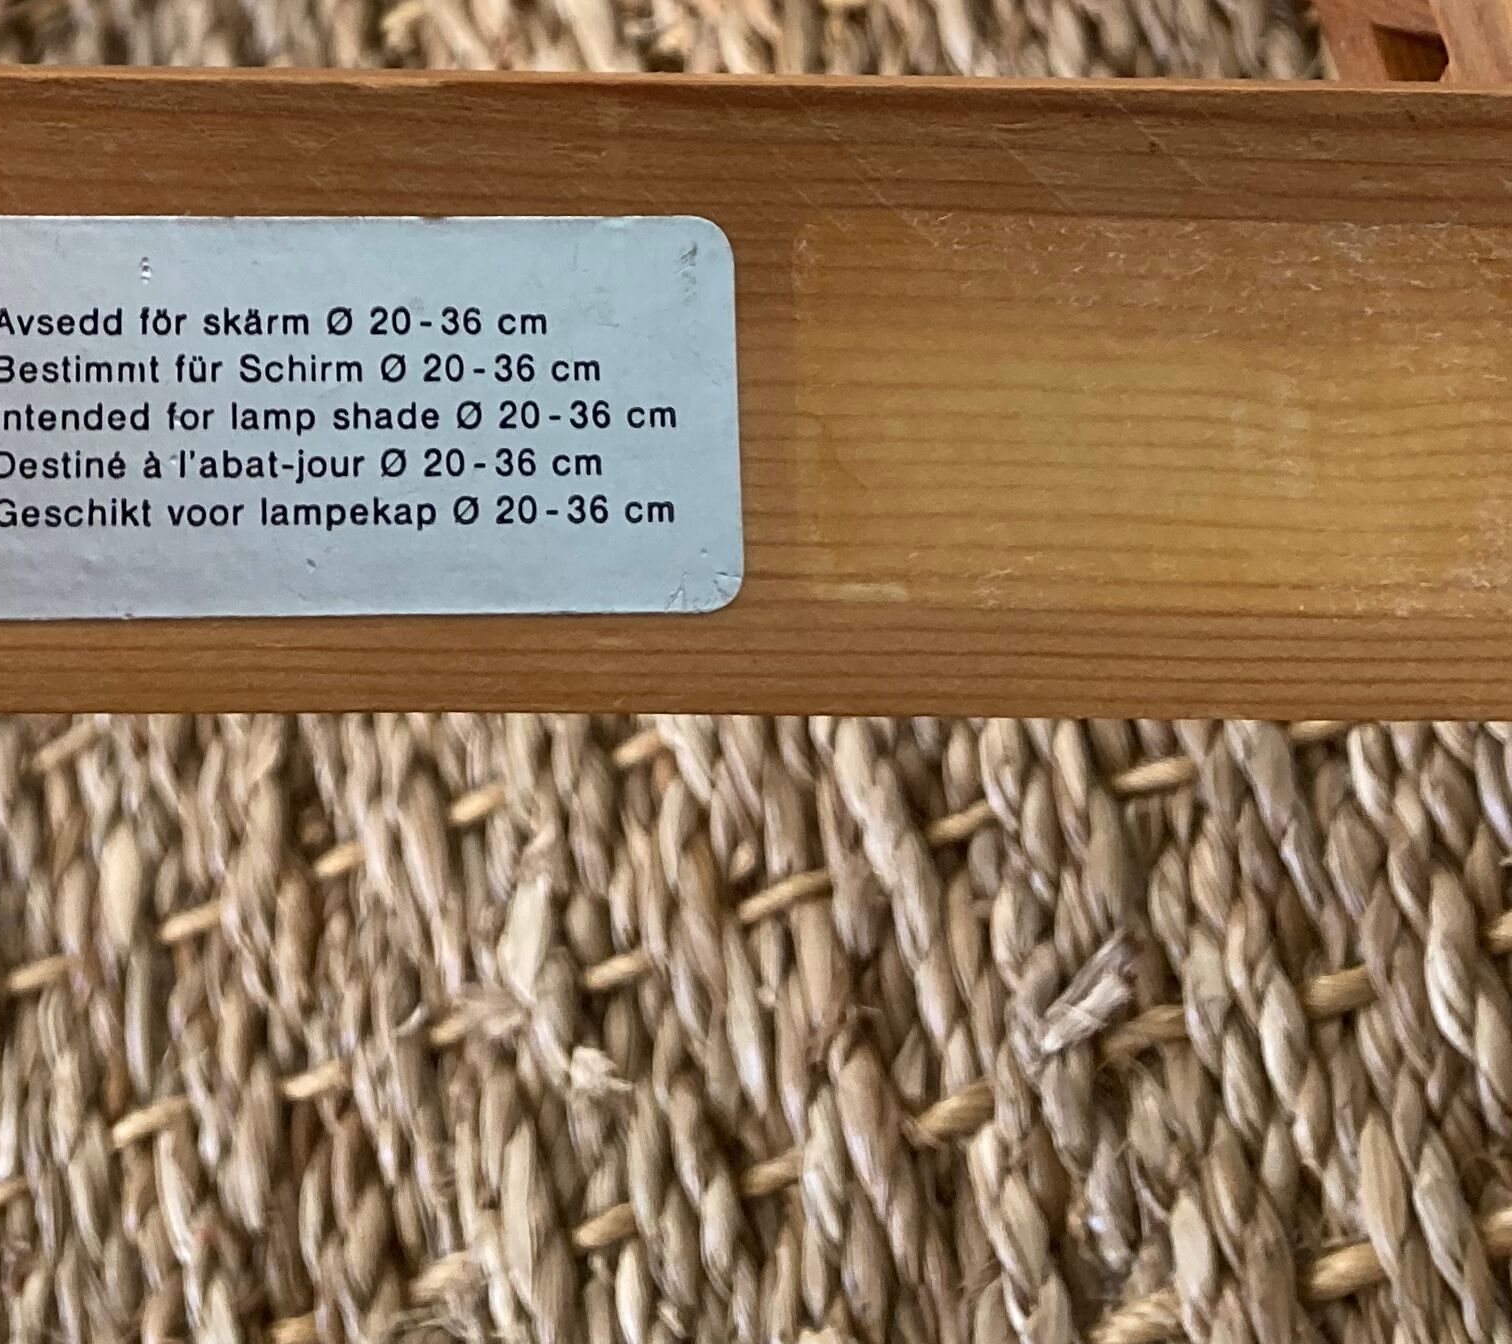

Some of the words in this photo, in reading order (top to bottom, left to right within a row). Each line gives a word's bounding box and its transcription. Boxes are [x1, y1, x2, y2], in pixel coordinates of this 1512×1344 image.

[139, 306, 188, 337] för
[202, 306, 310, 337] skärm
[326, 306, 353, 337] Ø
[369, 305, 482, 336] 20-36
[497, 313, 548, 336] cm
[174, 353, 224, 384] für
[239, 353, 363, 384] Schirm
[380, 352, 407, 384] Ø
[422, 352, 536, 383] 20-36
[550, 359, 601, 383] cm
[166, 401, 215, 432] for
[231, 401, 316, 437] lamp
[332, 401, 440, 431] shade
[456, 399, 483, 431] Ø
[498, 399, 611, 430] 20-36
[626, 406, 677, 429] cm
[142, 450, 163, 480] à
[179, 448, 366, 485] l'abat-jour
[380, 447, 407, 478] Ø
[423, 447, 537, 478] 20-36
[551, 453, 603, 477] cm
[167, 503, 245, 528] voor
[260, 495, 437, 532] lampekap
[452, 495, 480, 526] Ø
[495, 493, 609, 525] 20-36
[624, 500, 675, 524] cm
